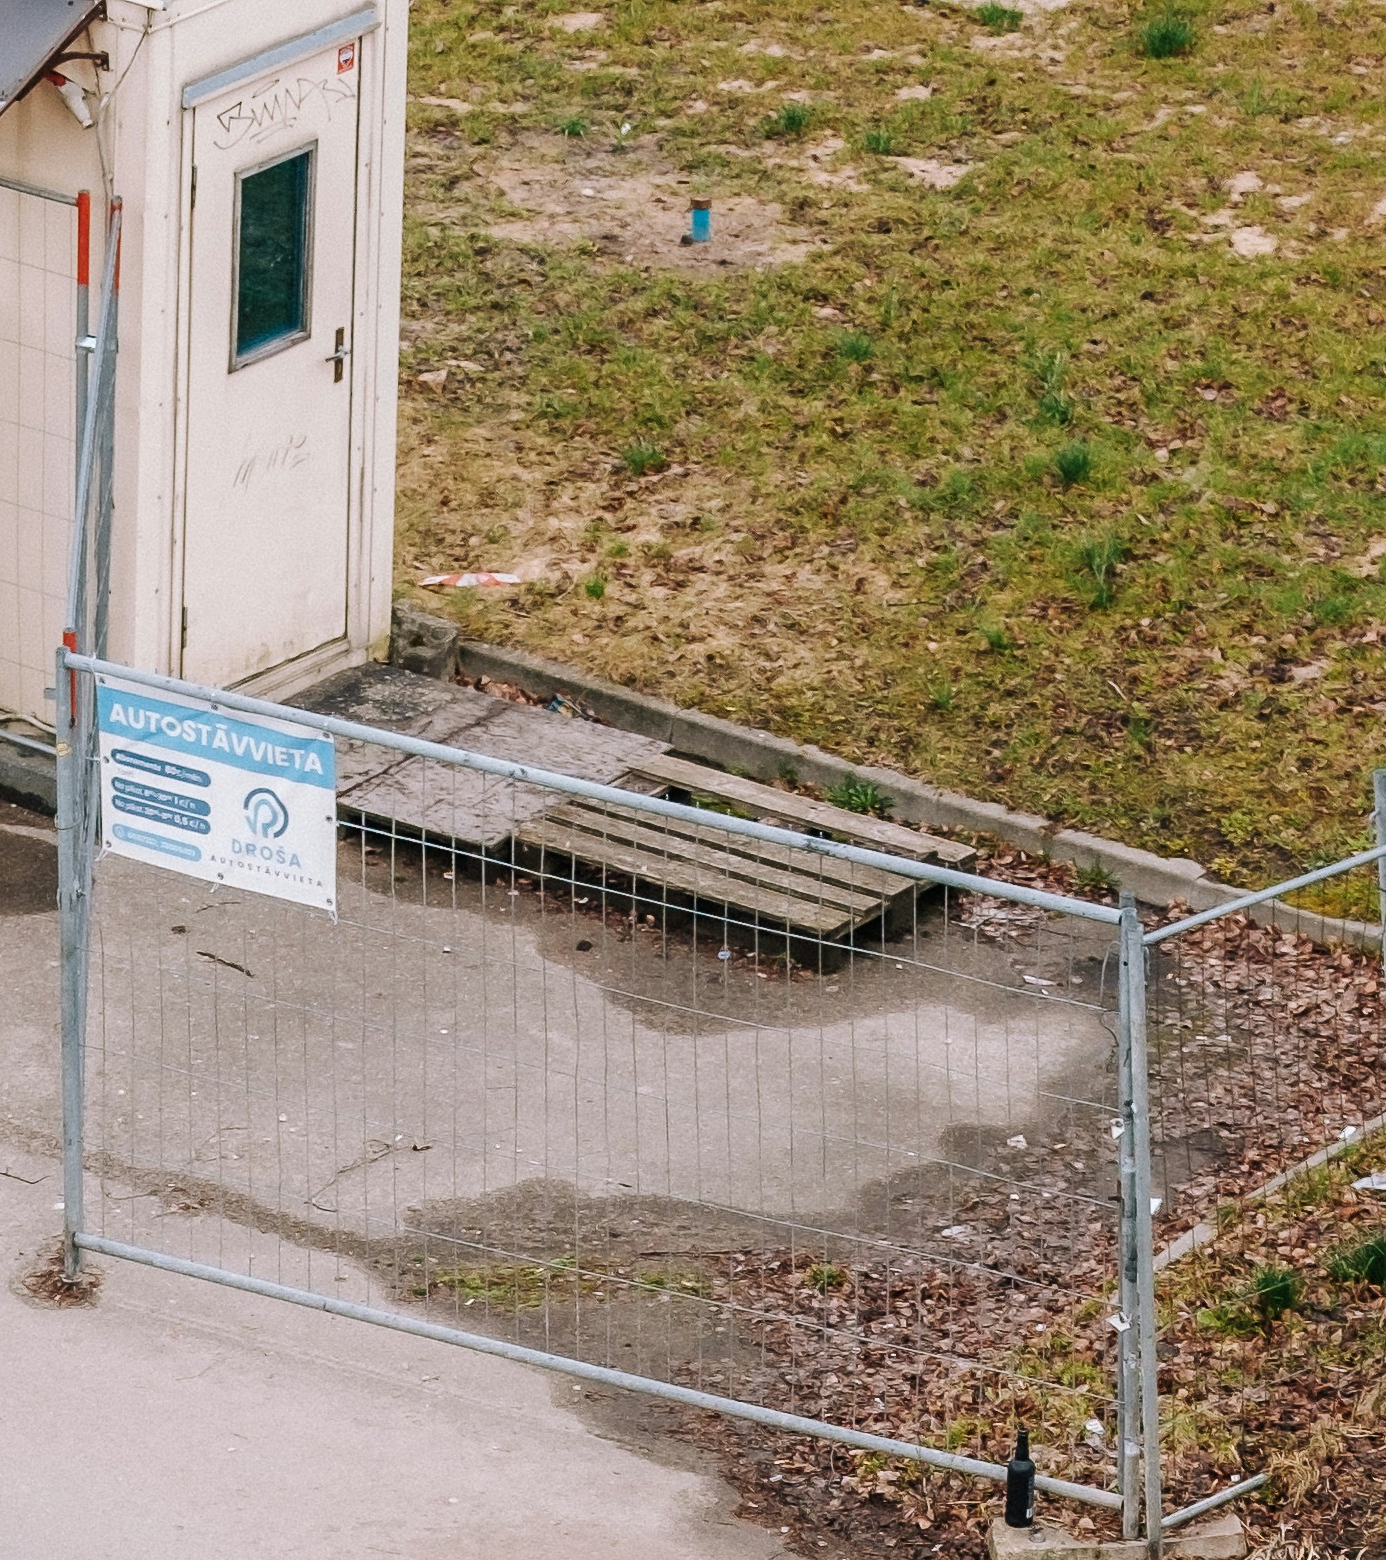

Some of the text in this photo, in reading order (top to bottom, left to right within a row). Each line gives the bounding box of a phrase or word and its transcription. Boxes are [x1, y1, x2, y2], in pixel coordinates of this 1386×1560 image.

[109, 703, 324, 775] AUTOSTĀVVIETA
[231, 838, 302, 869] DROŠA
[210, 854, 324, 888] AUTOSTĀVVIETA
